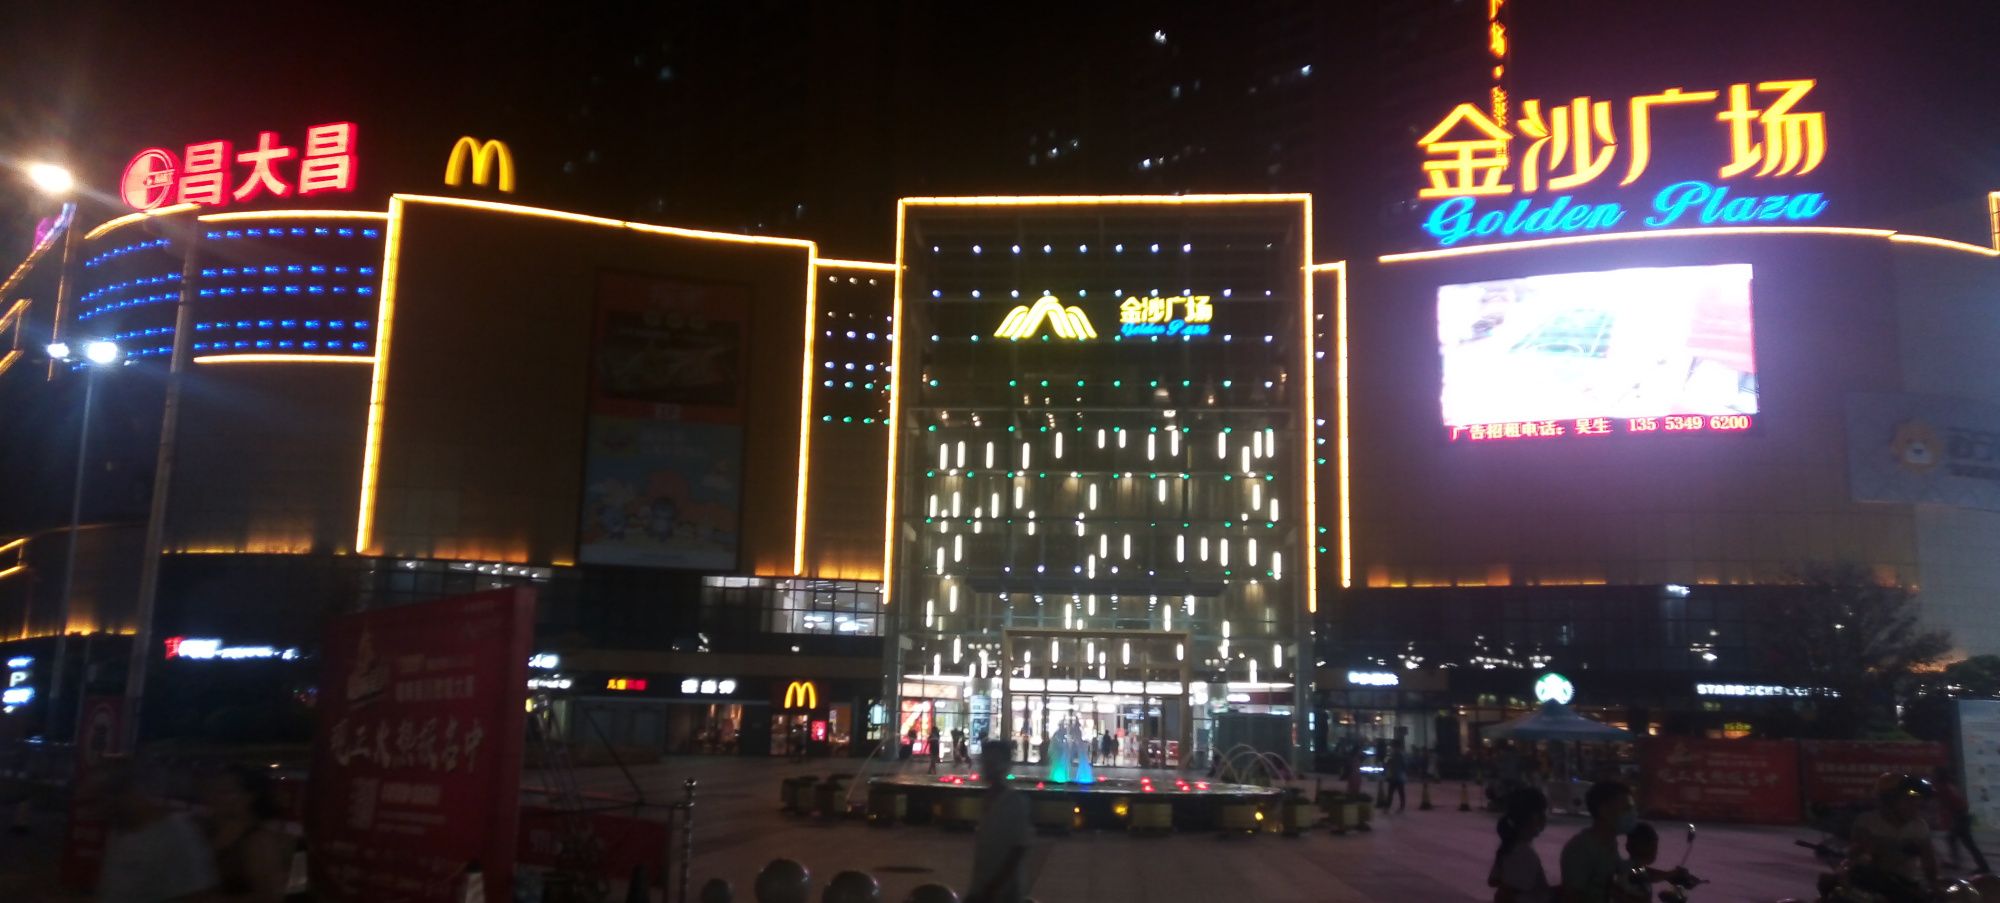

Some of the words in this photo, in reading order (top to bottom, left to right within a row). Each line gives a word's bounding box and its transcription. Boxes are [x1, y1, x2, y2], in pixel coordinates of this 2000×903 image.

[177, 122, 356, 206] 昌大昌
[1417, 79, 1826, 198] 金沙广场
[1422, 196, 1627, 245] Golden
[1645, 181, 1829, 227] Plaza
[1120, 295, 1214, 323] 金沙广场
[1574, 416, 1612, 434] 吴生
[1629, 417, 1657, 432] 135
[1664, 415, 1703, 430] 5349
[1710, 414, 1749, 430] 6200
